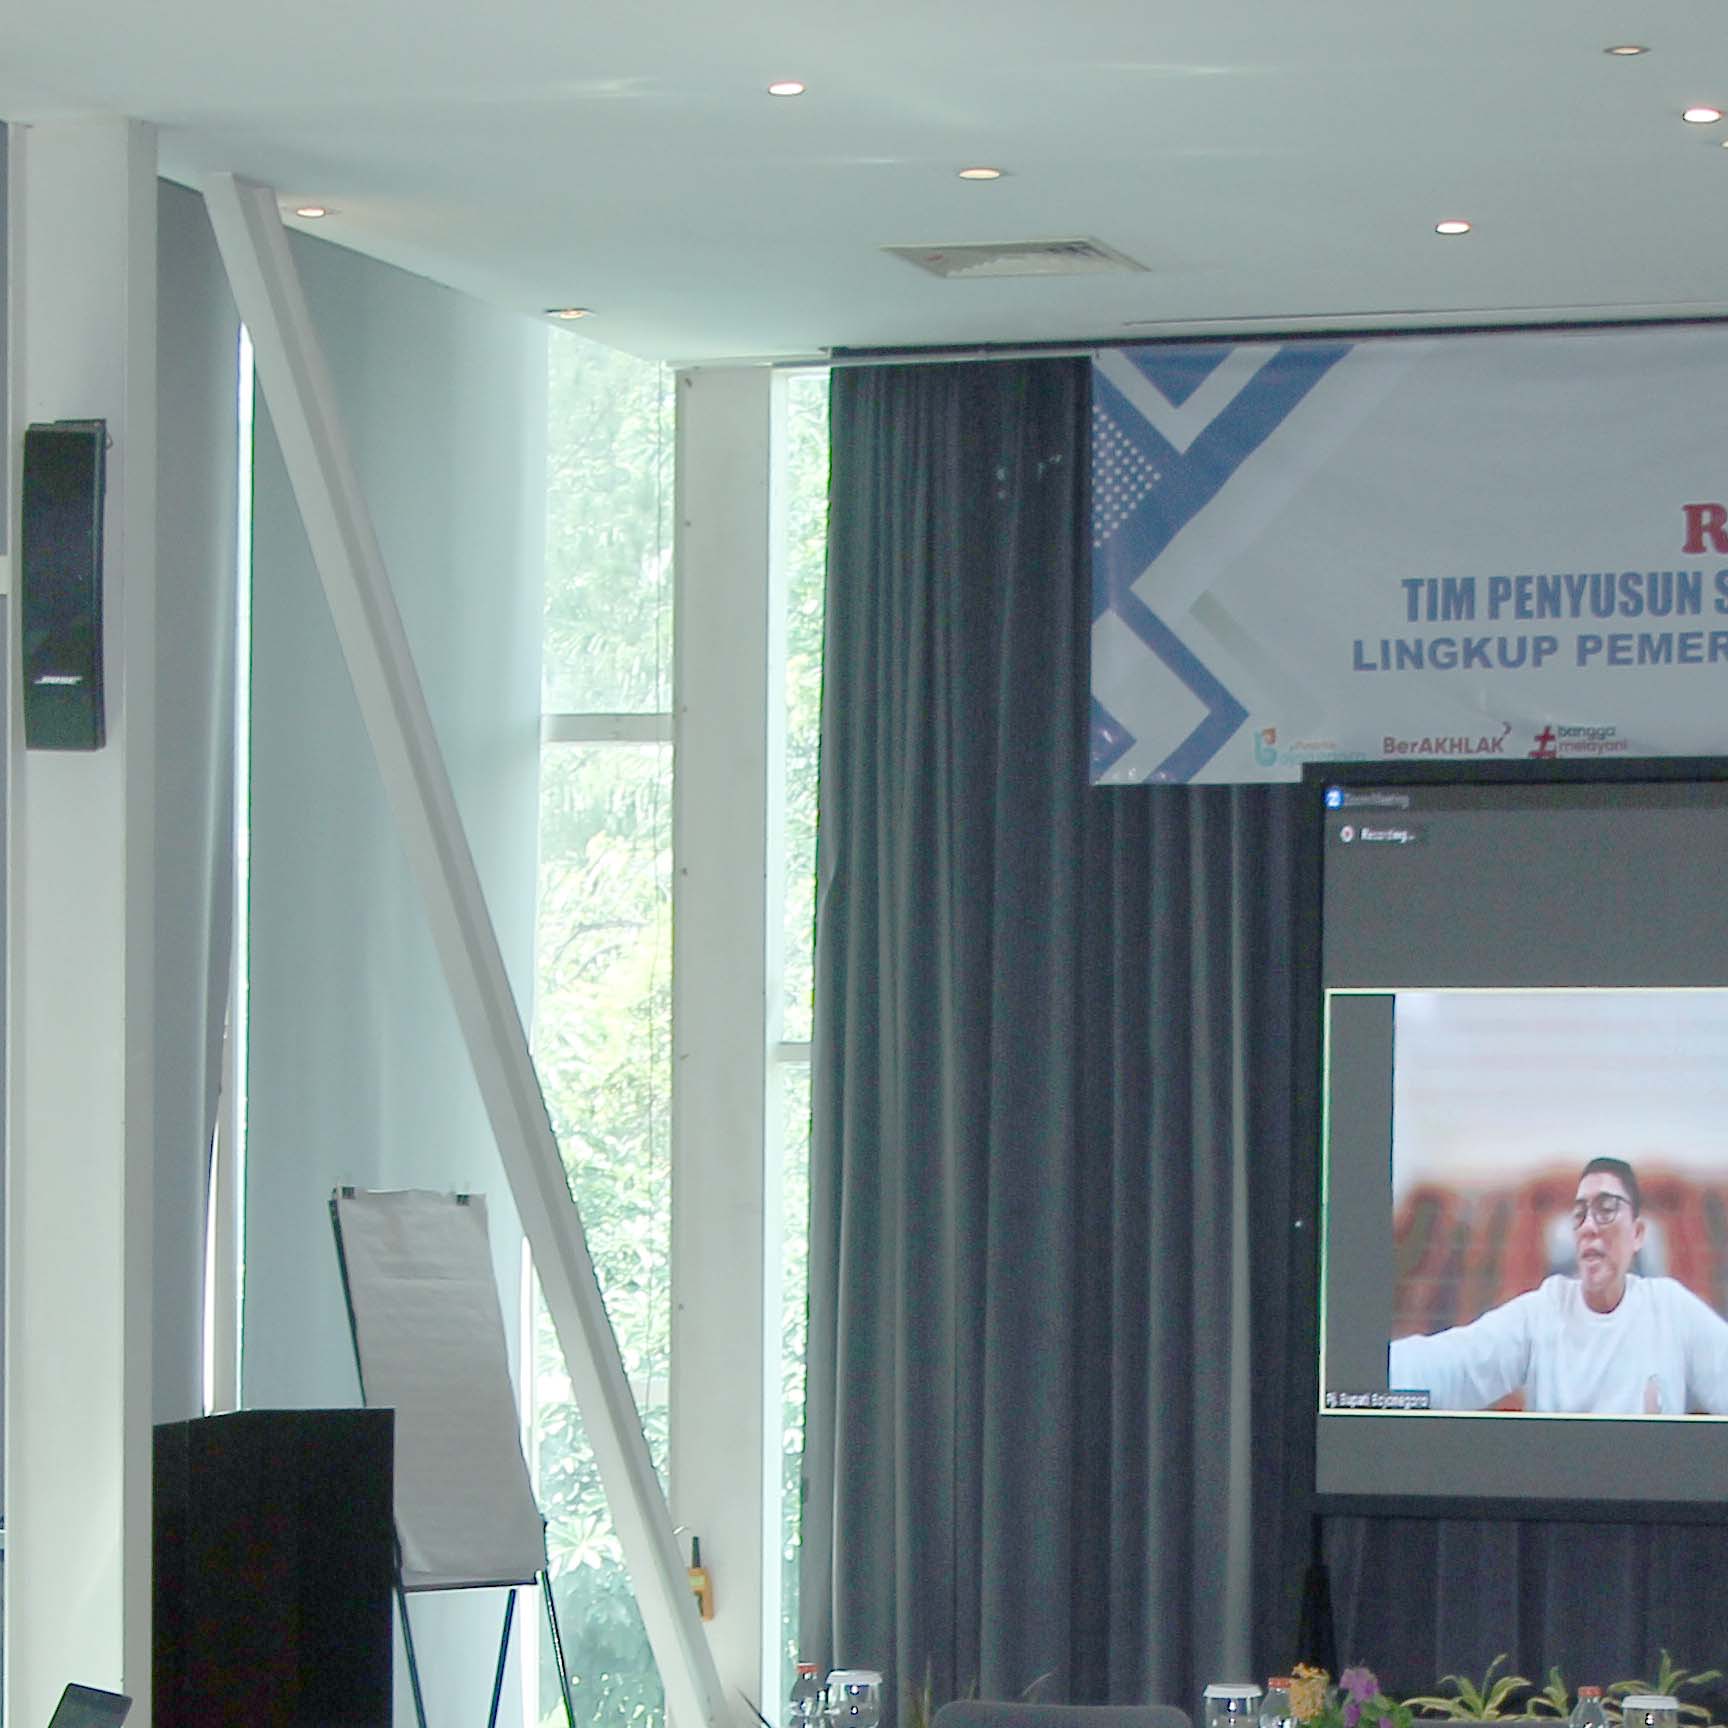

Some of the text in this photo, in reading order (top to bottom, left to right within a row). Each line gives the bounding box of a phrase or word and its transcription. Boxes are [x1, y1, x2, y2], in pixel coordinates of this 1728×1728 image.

[1401, 576, 1475, 622] TIM
[1488, 570, 1703, 620] PENYUSUN
[1353, 635, 1559, 672] LINGKUP
[1383, 736, 1505, 755] BerAKHLAK
[1557, 725, 1616, 740] bangga
